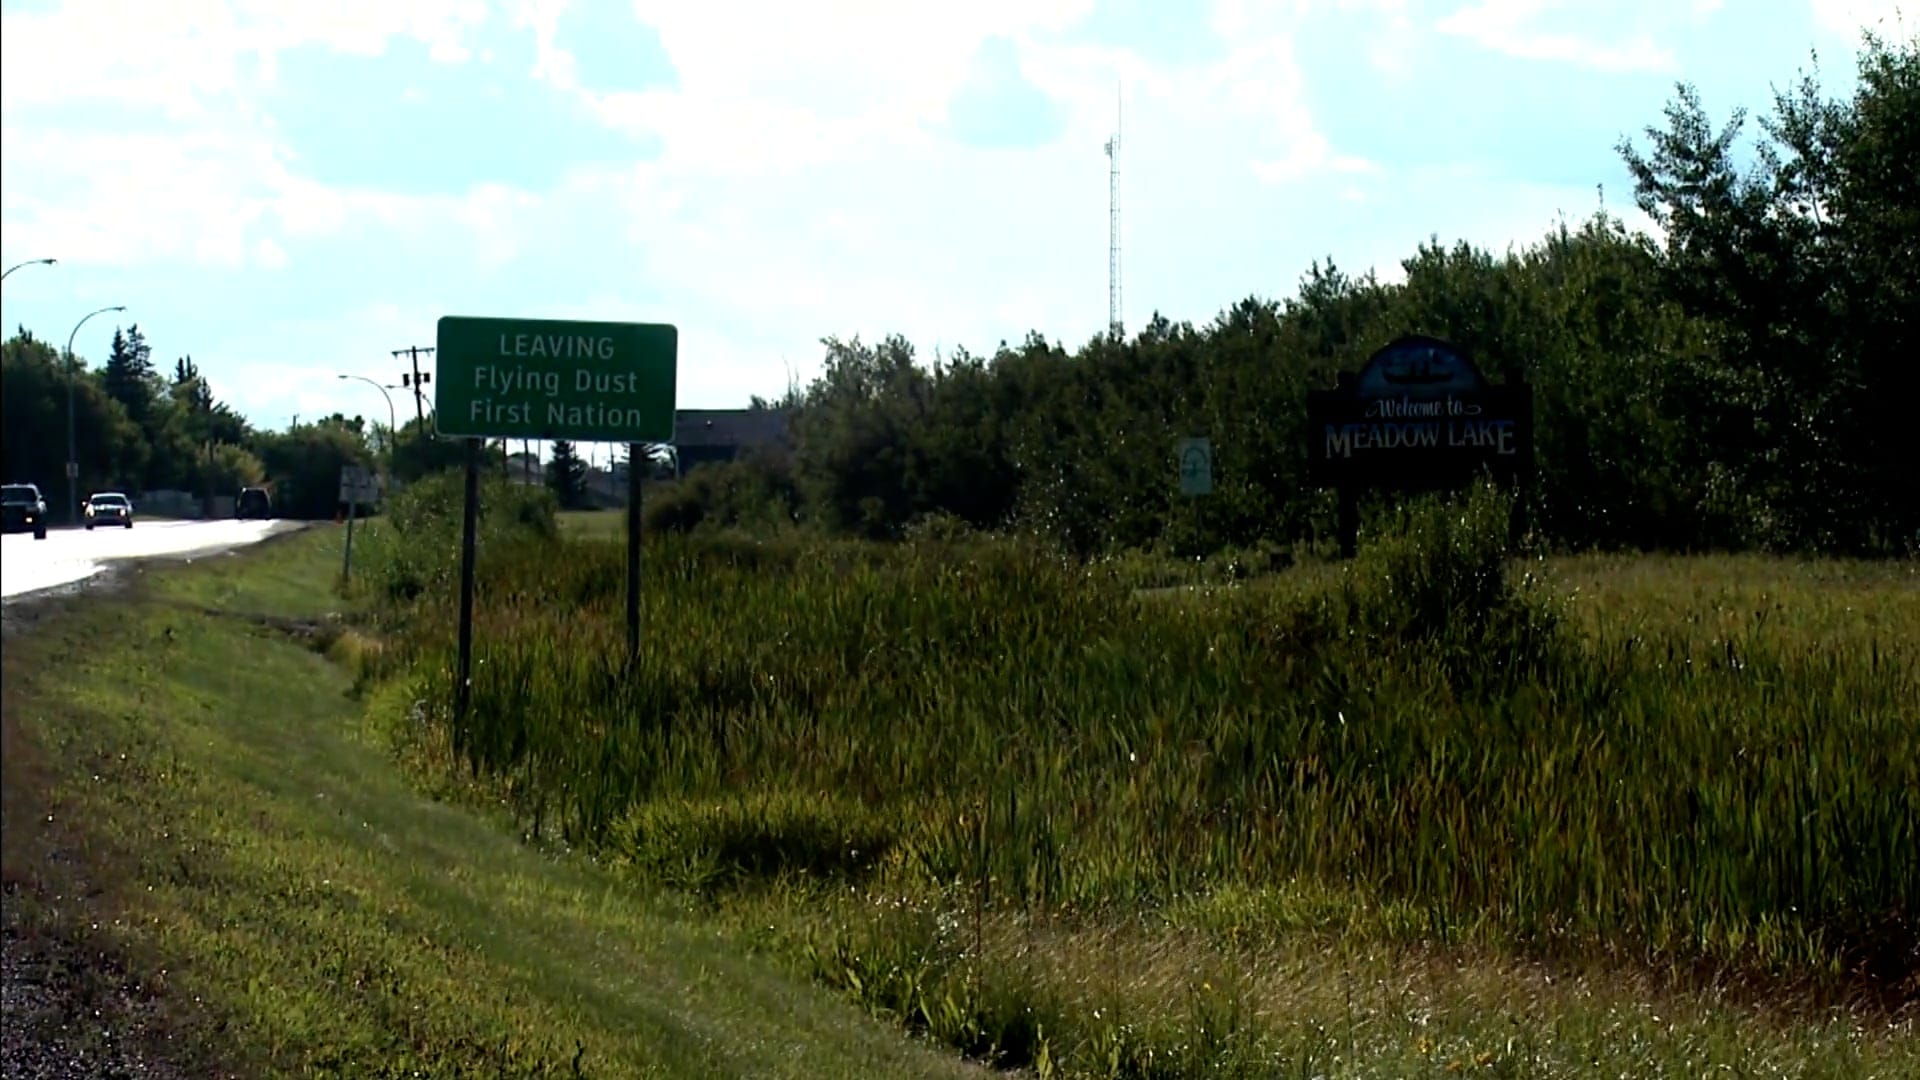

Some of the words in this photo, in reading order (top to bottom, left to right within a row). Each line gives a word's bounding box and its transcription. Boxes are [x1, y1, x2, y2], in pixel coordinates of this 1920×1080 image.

[500, 333, 614, 360] LEAVING
[474, 365, 560, 397] Flying
[575, 369, 637, 393] Dust
[470, 398, 531, 424] First
[547, 402, 641, 427] Nation
[1366, 394, 1443, 418] Welcome
[1448, 393, 1471, 417] to
[1325, 421, 1440, 458] MEADOW
[1448, 420, 1516, 455] LAKE
